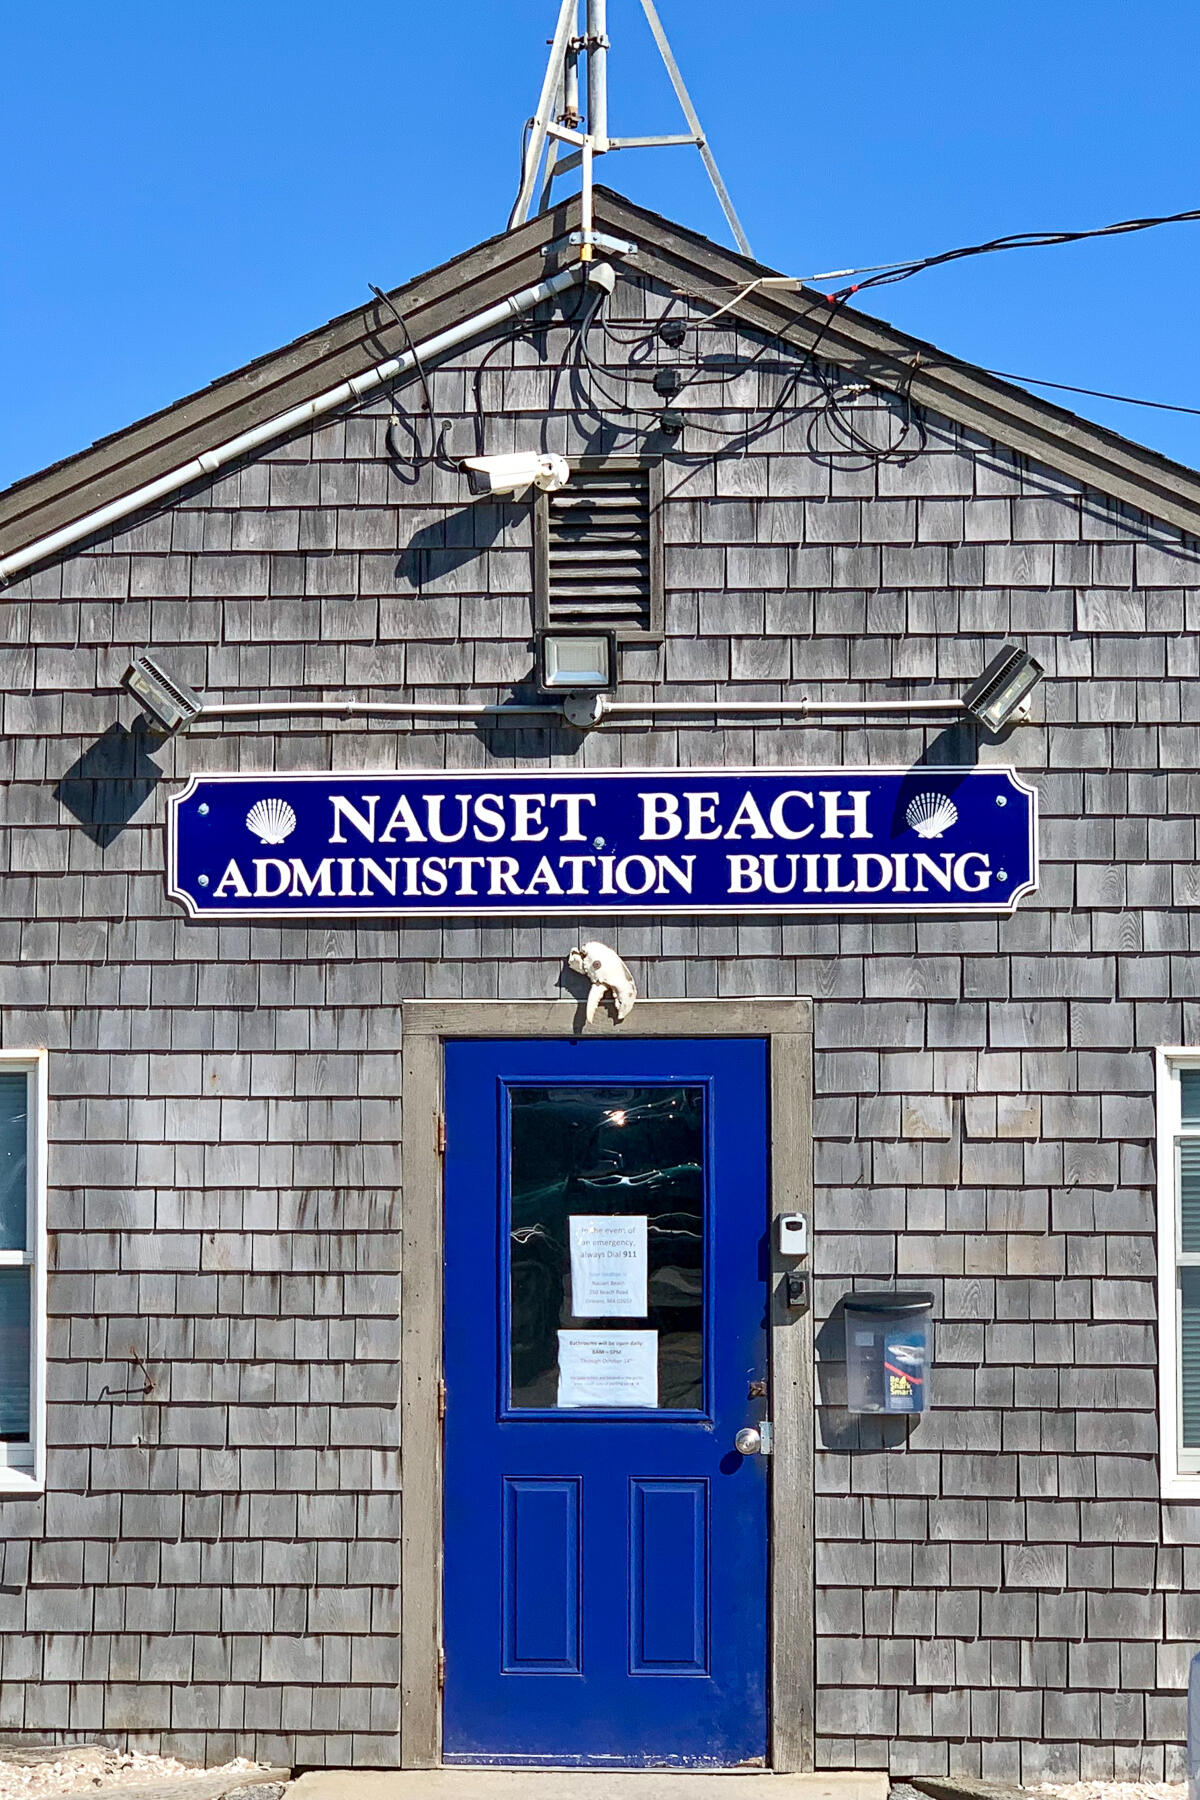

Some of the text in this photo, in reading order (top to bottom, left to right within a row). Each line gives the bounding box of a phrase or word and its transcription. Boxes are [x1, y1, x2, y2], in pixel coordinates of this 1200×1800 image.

[329, 791, 873, 843] NAUSET BEACH
[213, 853, 992, 897] ADMINISTRATION BUILDING
[580, 1251, 605, 1259] always
[622, 1250, 637, 1258] 911
